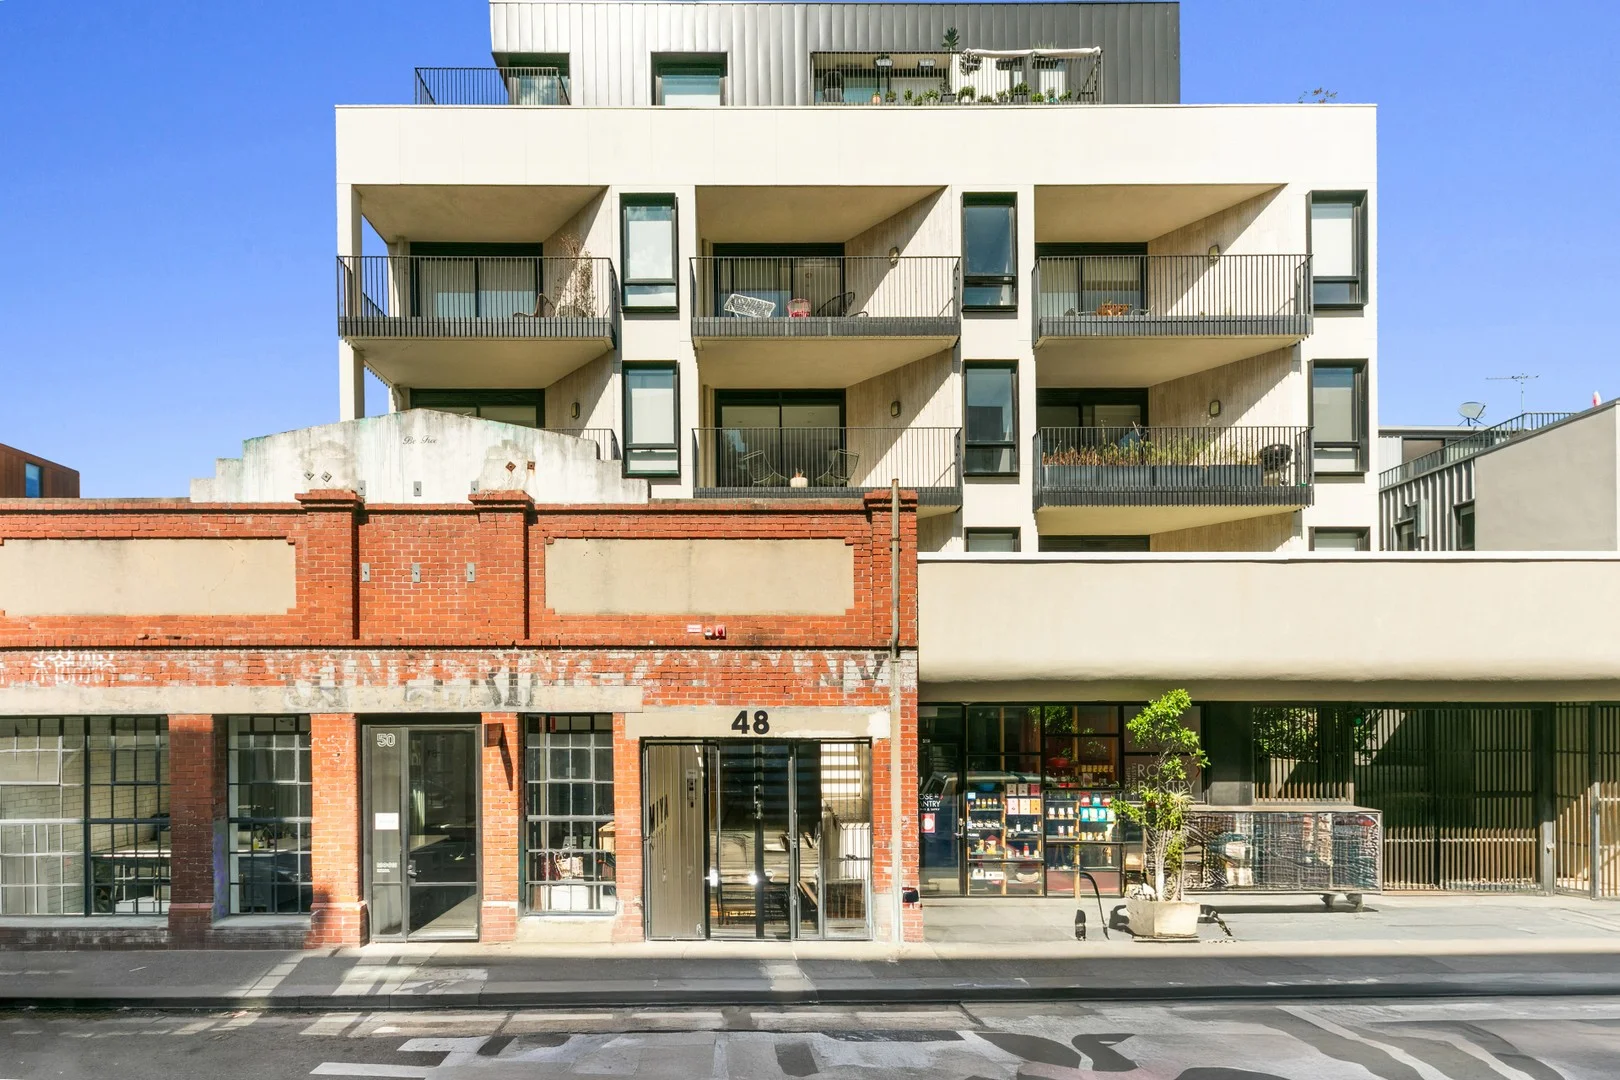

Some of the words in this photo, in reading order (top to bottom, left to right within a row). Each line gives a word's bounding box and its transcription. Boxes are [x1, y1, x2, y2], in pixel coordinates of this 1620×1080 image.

[402, 435, 416, 445] Be
[731, 710, 770, 734] 48
[376, 733, 396, 747] 50
